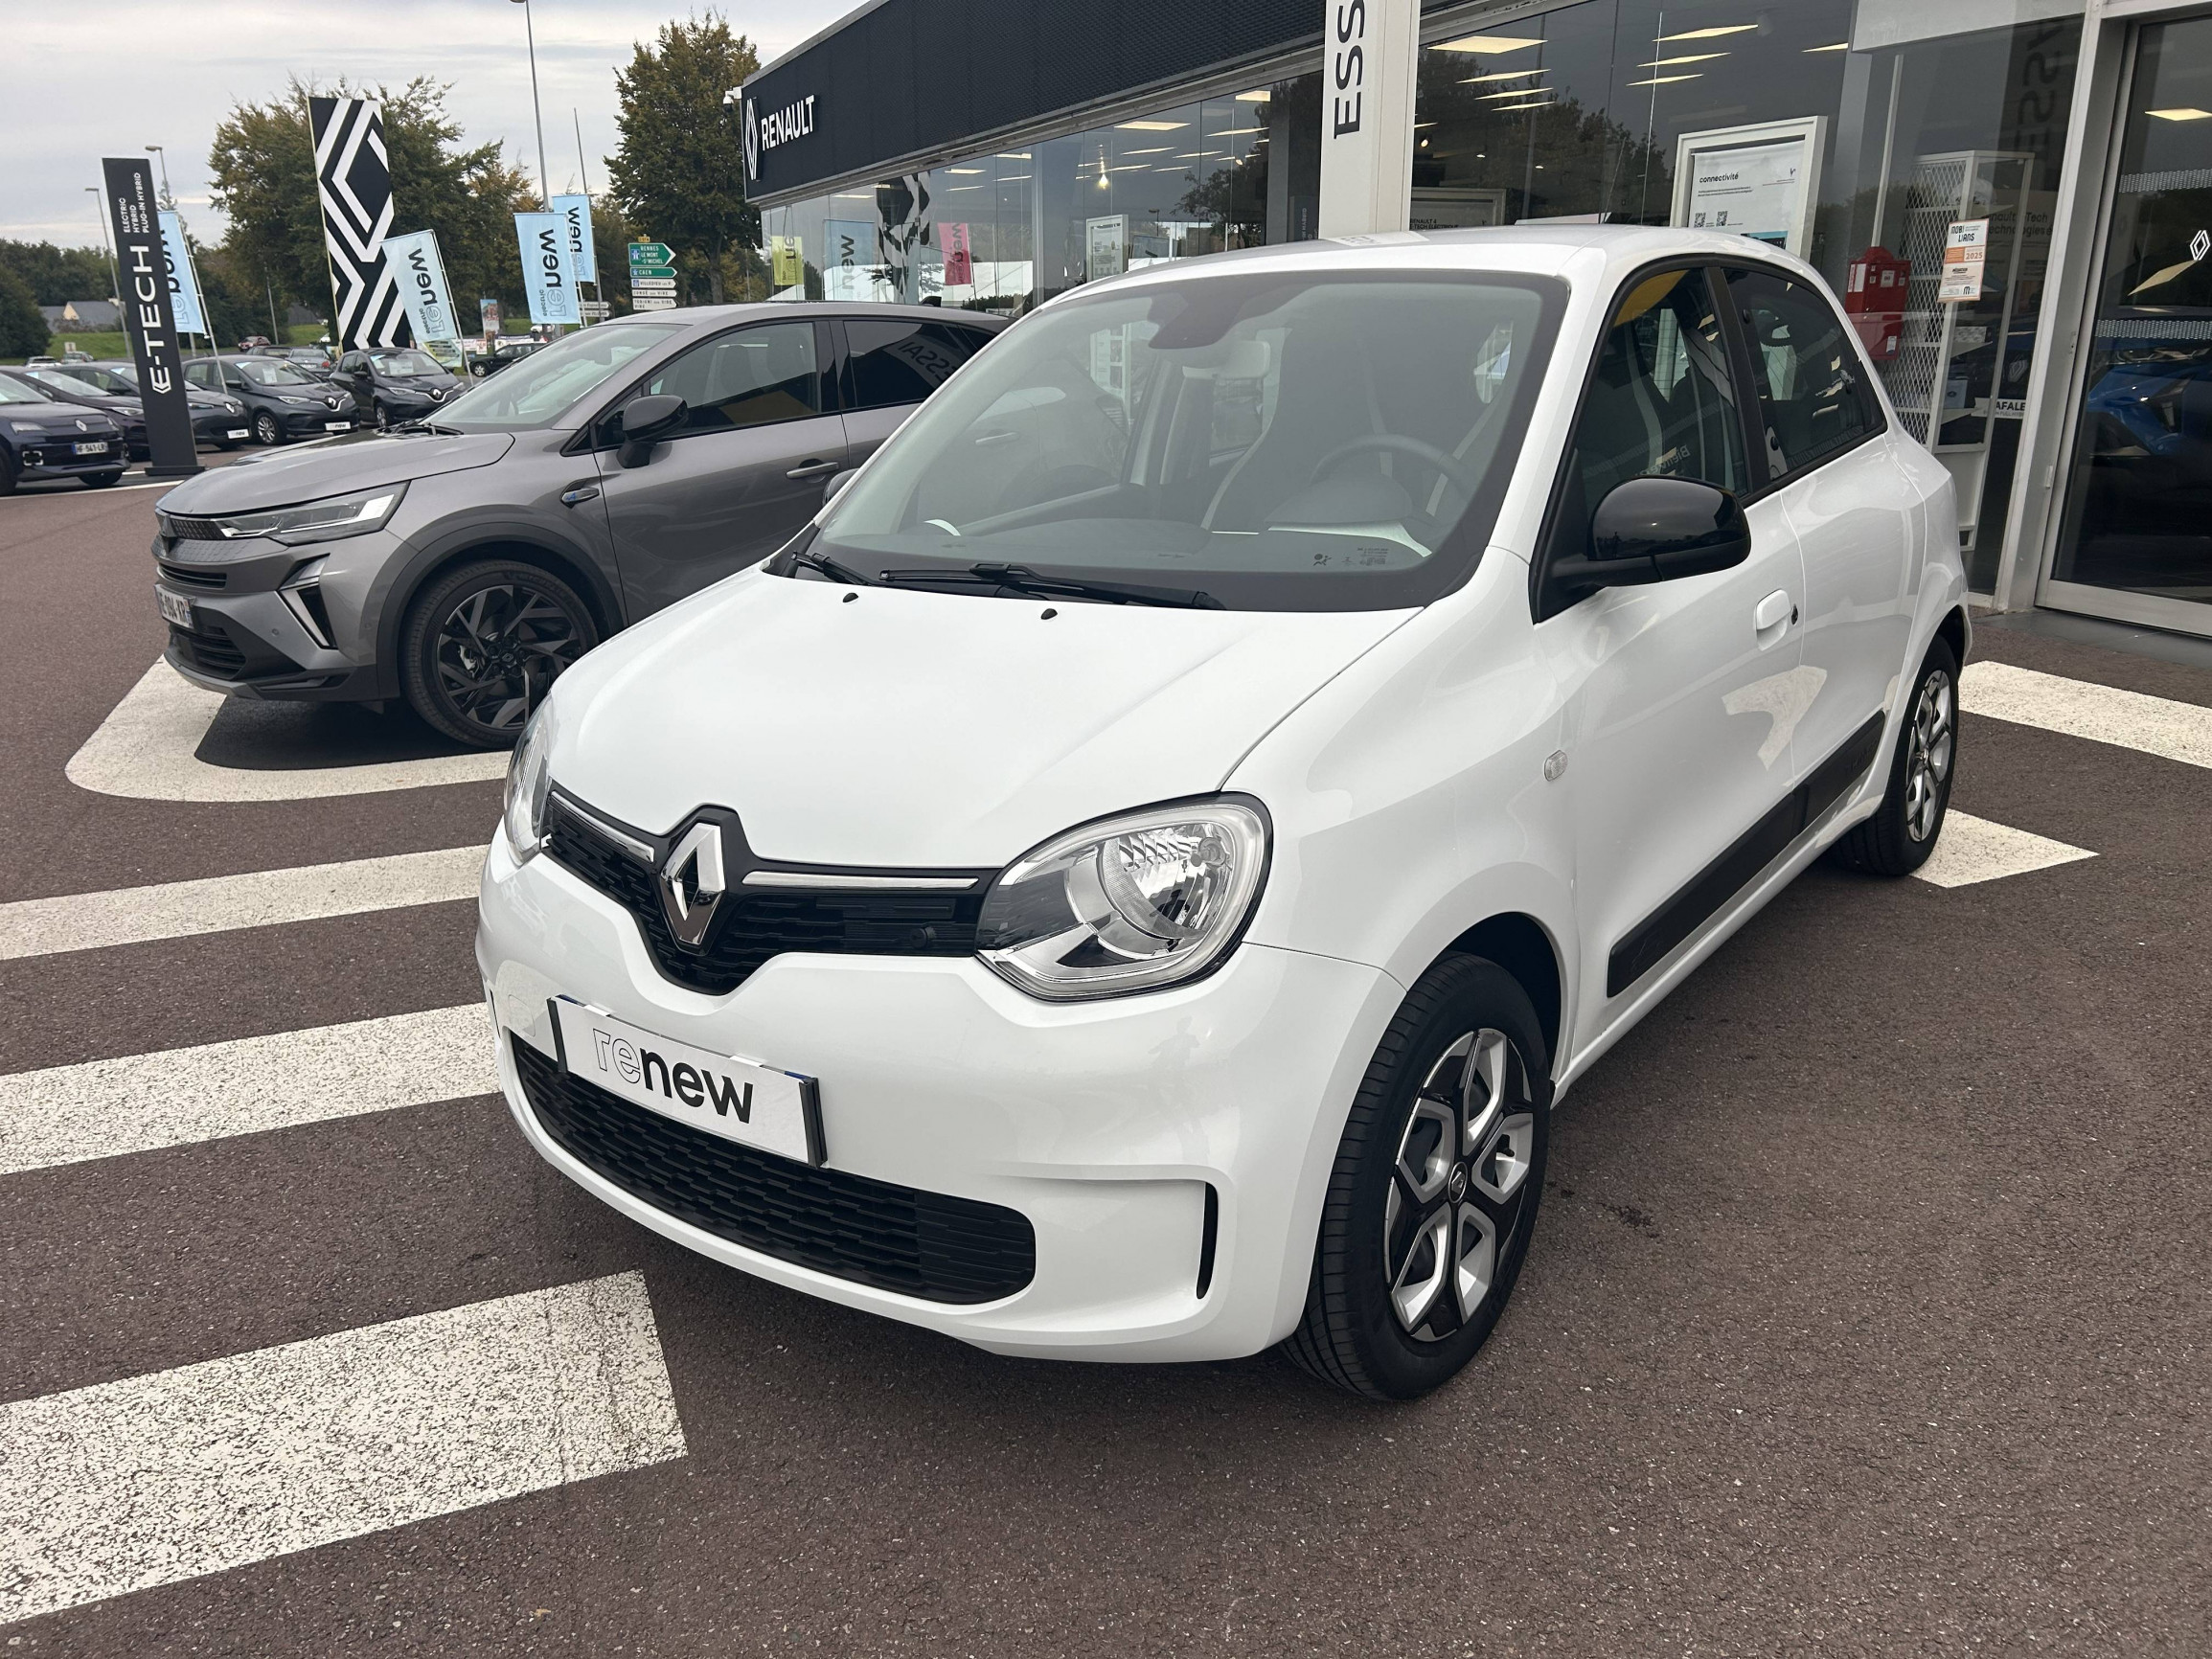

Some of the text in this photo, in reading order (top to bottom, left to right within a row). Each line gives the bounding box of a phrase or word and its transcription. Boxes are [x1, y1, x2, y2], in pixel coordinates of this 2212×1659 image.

[761, 94, 815, 151] RENAULT
[1699, 172, 1740, 184] connectivité
[119, 197, 131, 233] ELECTRIC
[129, 204, 141, 234] HYBRID
[133, 171, 150, 234] PLUG-IN HYBRID
[129, 245, 171, 394] E-TECH
[1995, 400, 2026, 412] AFALE
[592, 1028, 753, 1124] renew
